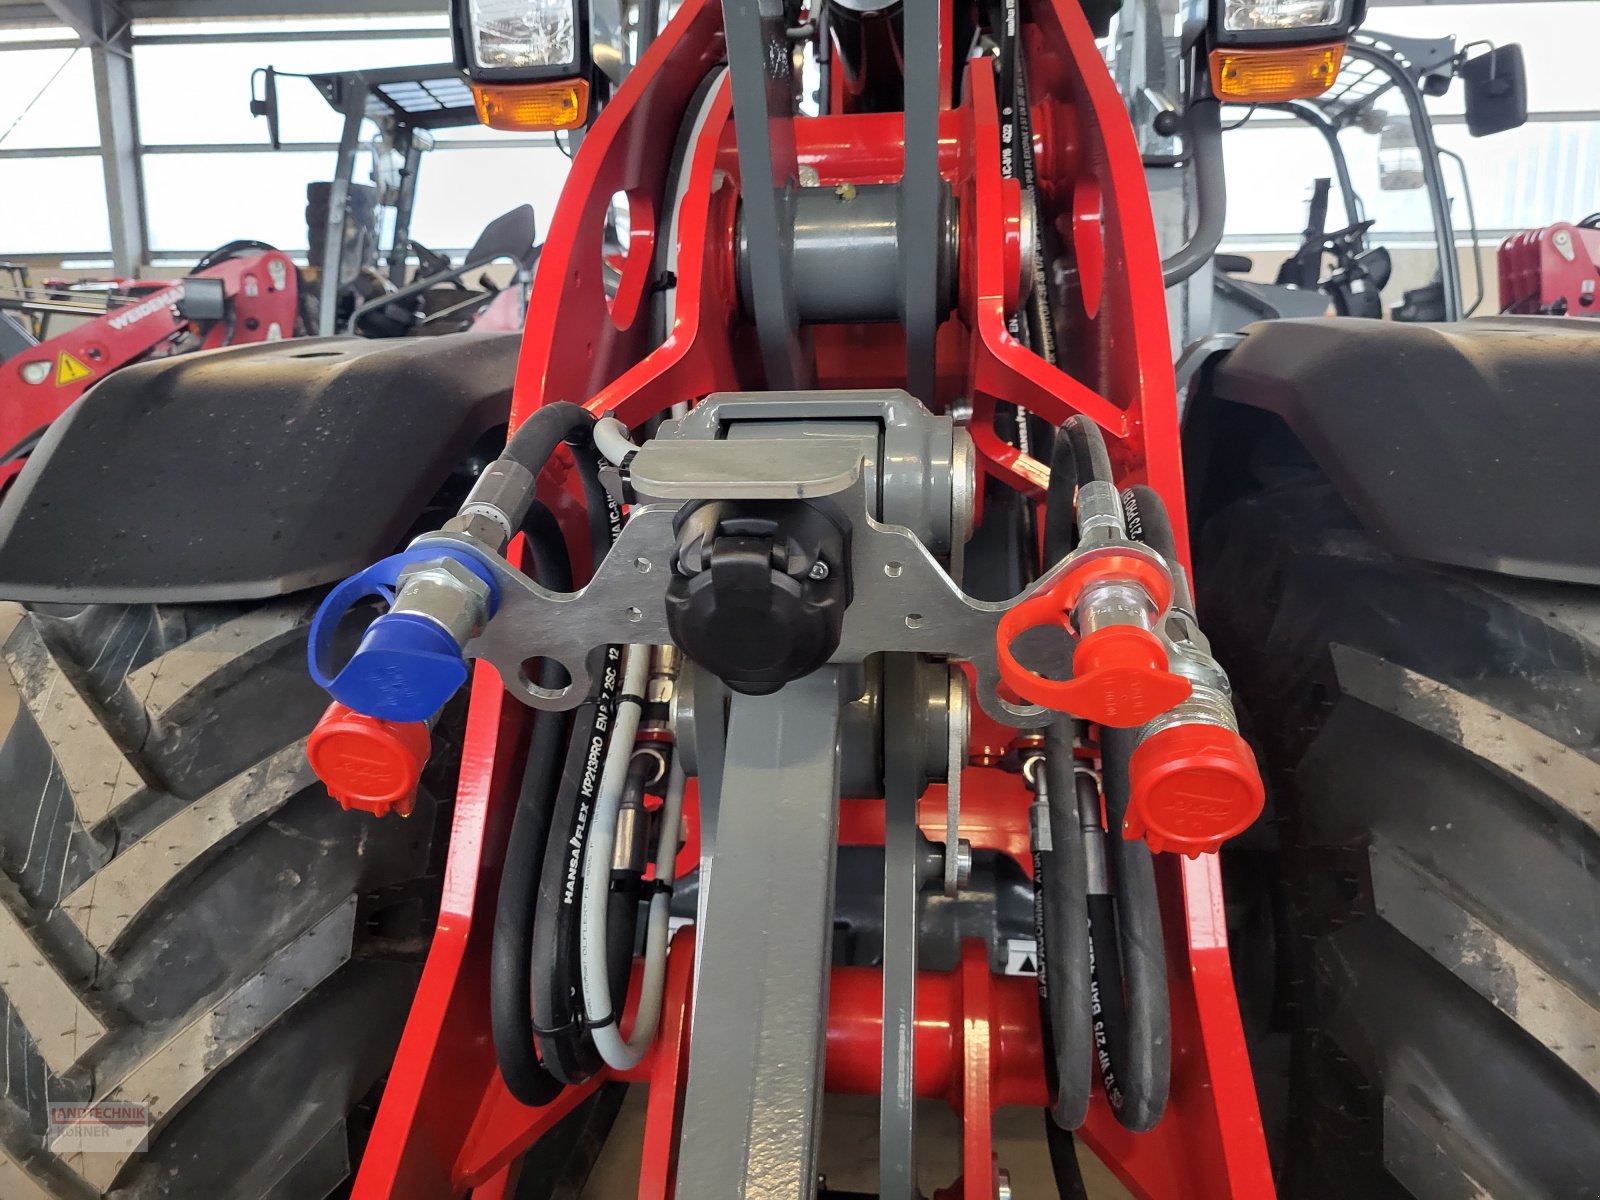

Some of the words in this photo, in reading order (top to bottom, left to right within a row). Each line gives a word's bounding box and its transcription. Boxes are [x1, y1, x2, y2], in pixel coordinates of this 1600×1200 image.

[608, 648, 619, 661] 12
[604, 667, 617, 691] 2SC
[596, 712, 609, 732] EN
[581, 736, 604, 798] KP213PRO
[1094, 1020, 1106, 1045] 275
[1098, 1050, 1113, 1074] WP
[1104, 1073, 1116, 1087] 12
